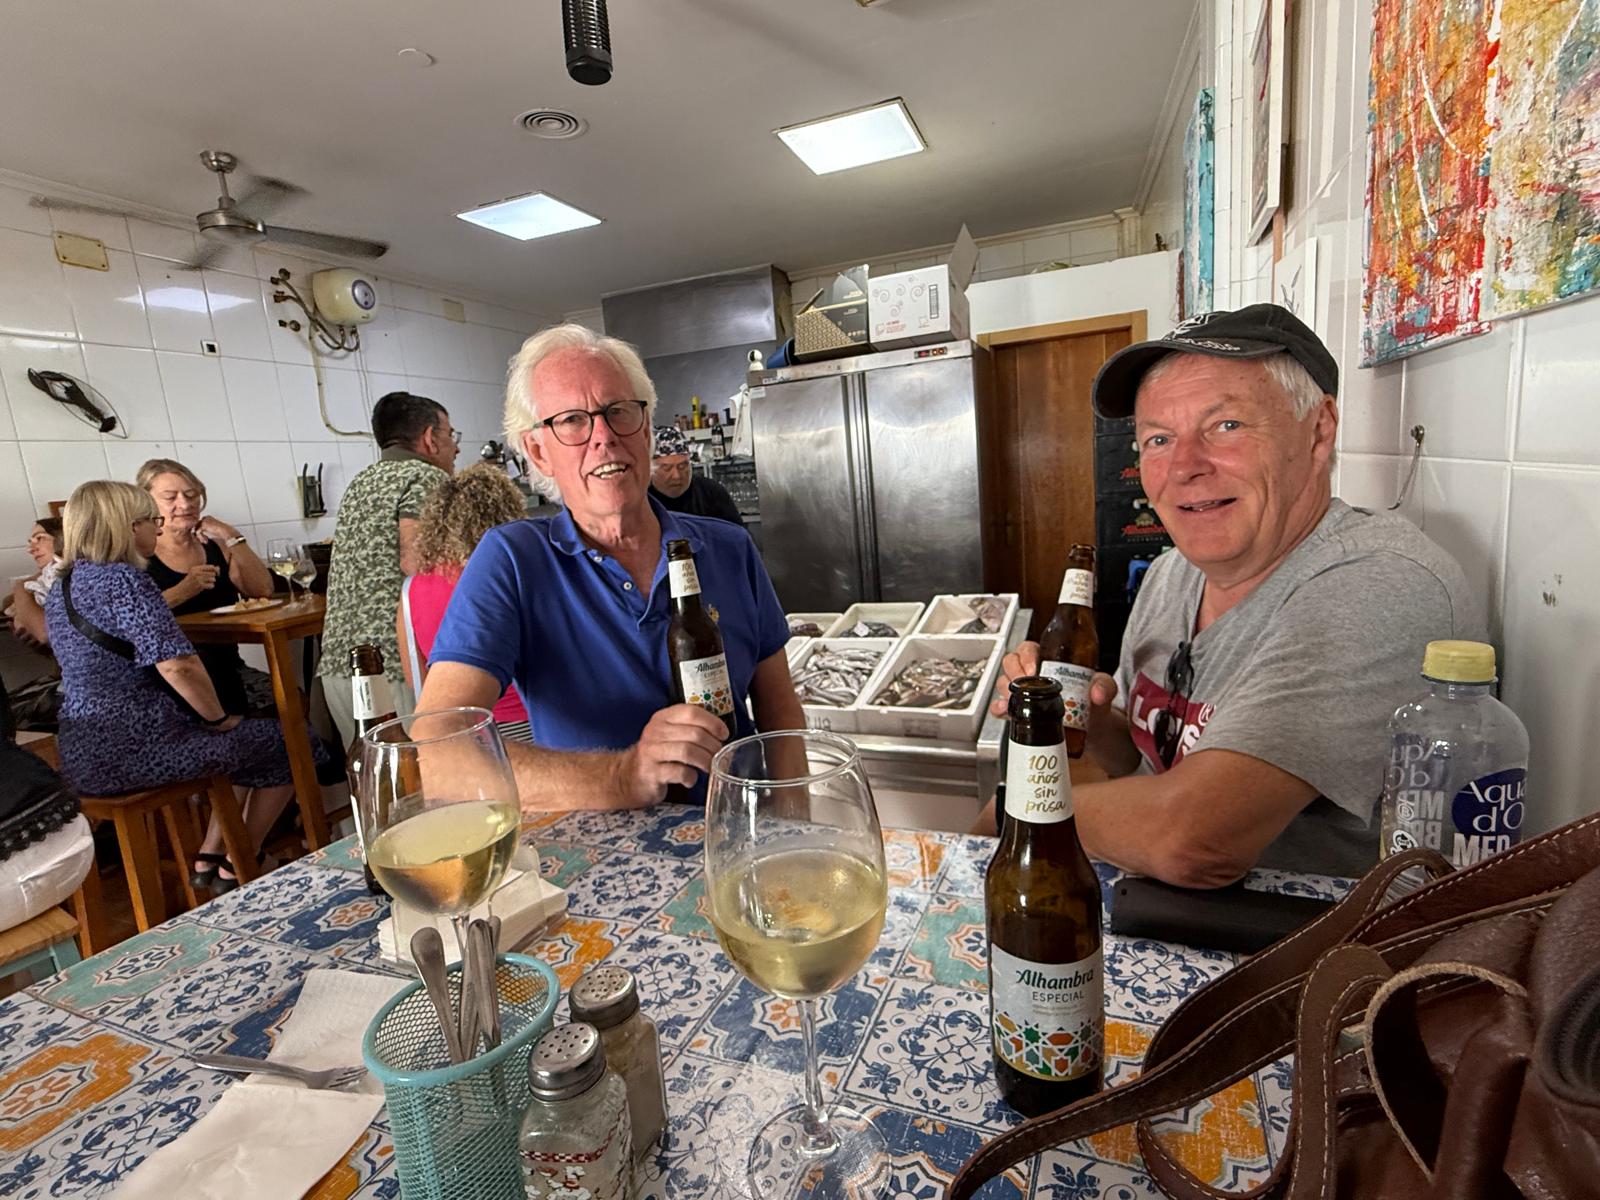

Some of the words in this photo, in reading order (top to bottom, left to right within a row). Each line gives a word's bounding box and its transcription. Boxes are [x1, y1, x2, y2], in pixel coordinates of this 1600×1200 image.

[1028, 755, 1058, 770] 100
[1027, 771, 1062, 784] años
[1034, 786, 1058, 799] sin
[1026, 799, 1066, 814] prisa
[1015, 968, 1094, 990] Alhambra
[1032, 990, 1085, 1003] ESPECIAL
